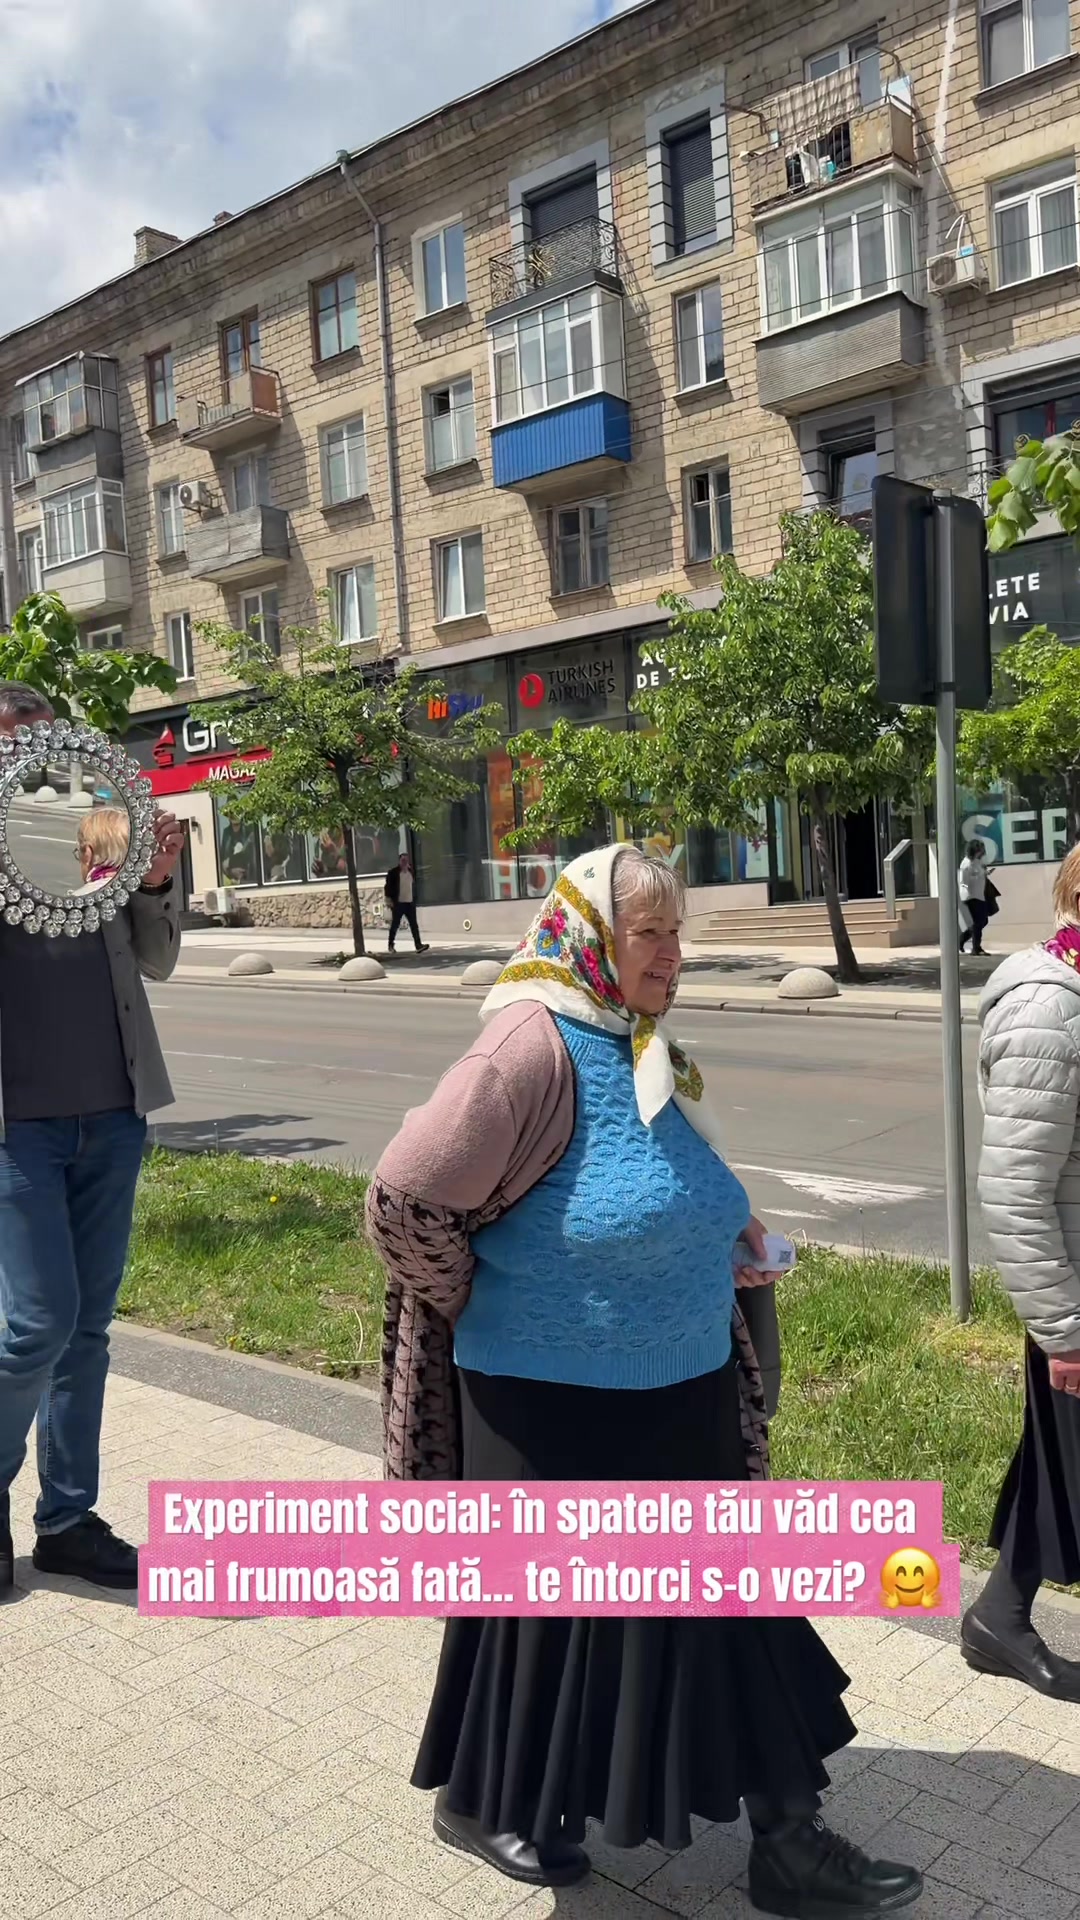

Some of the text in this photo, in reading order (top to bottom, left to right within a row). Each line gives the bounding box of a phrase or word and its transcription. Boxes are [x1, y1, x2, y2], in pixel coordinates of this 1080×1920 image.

[988, 572, 1040, 599] ETE
[547, 659, 614, 684] TURKISH
[636, 671, 660, 689] DE
[548, 677, 616, 703] AIRLINES
